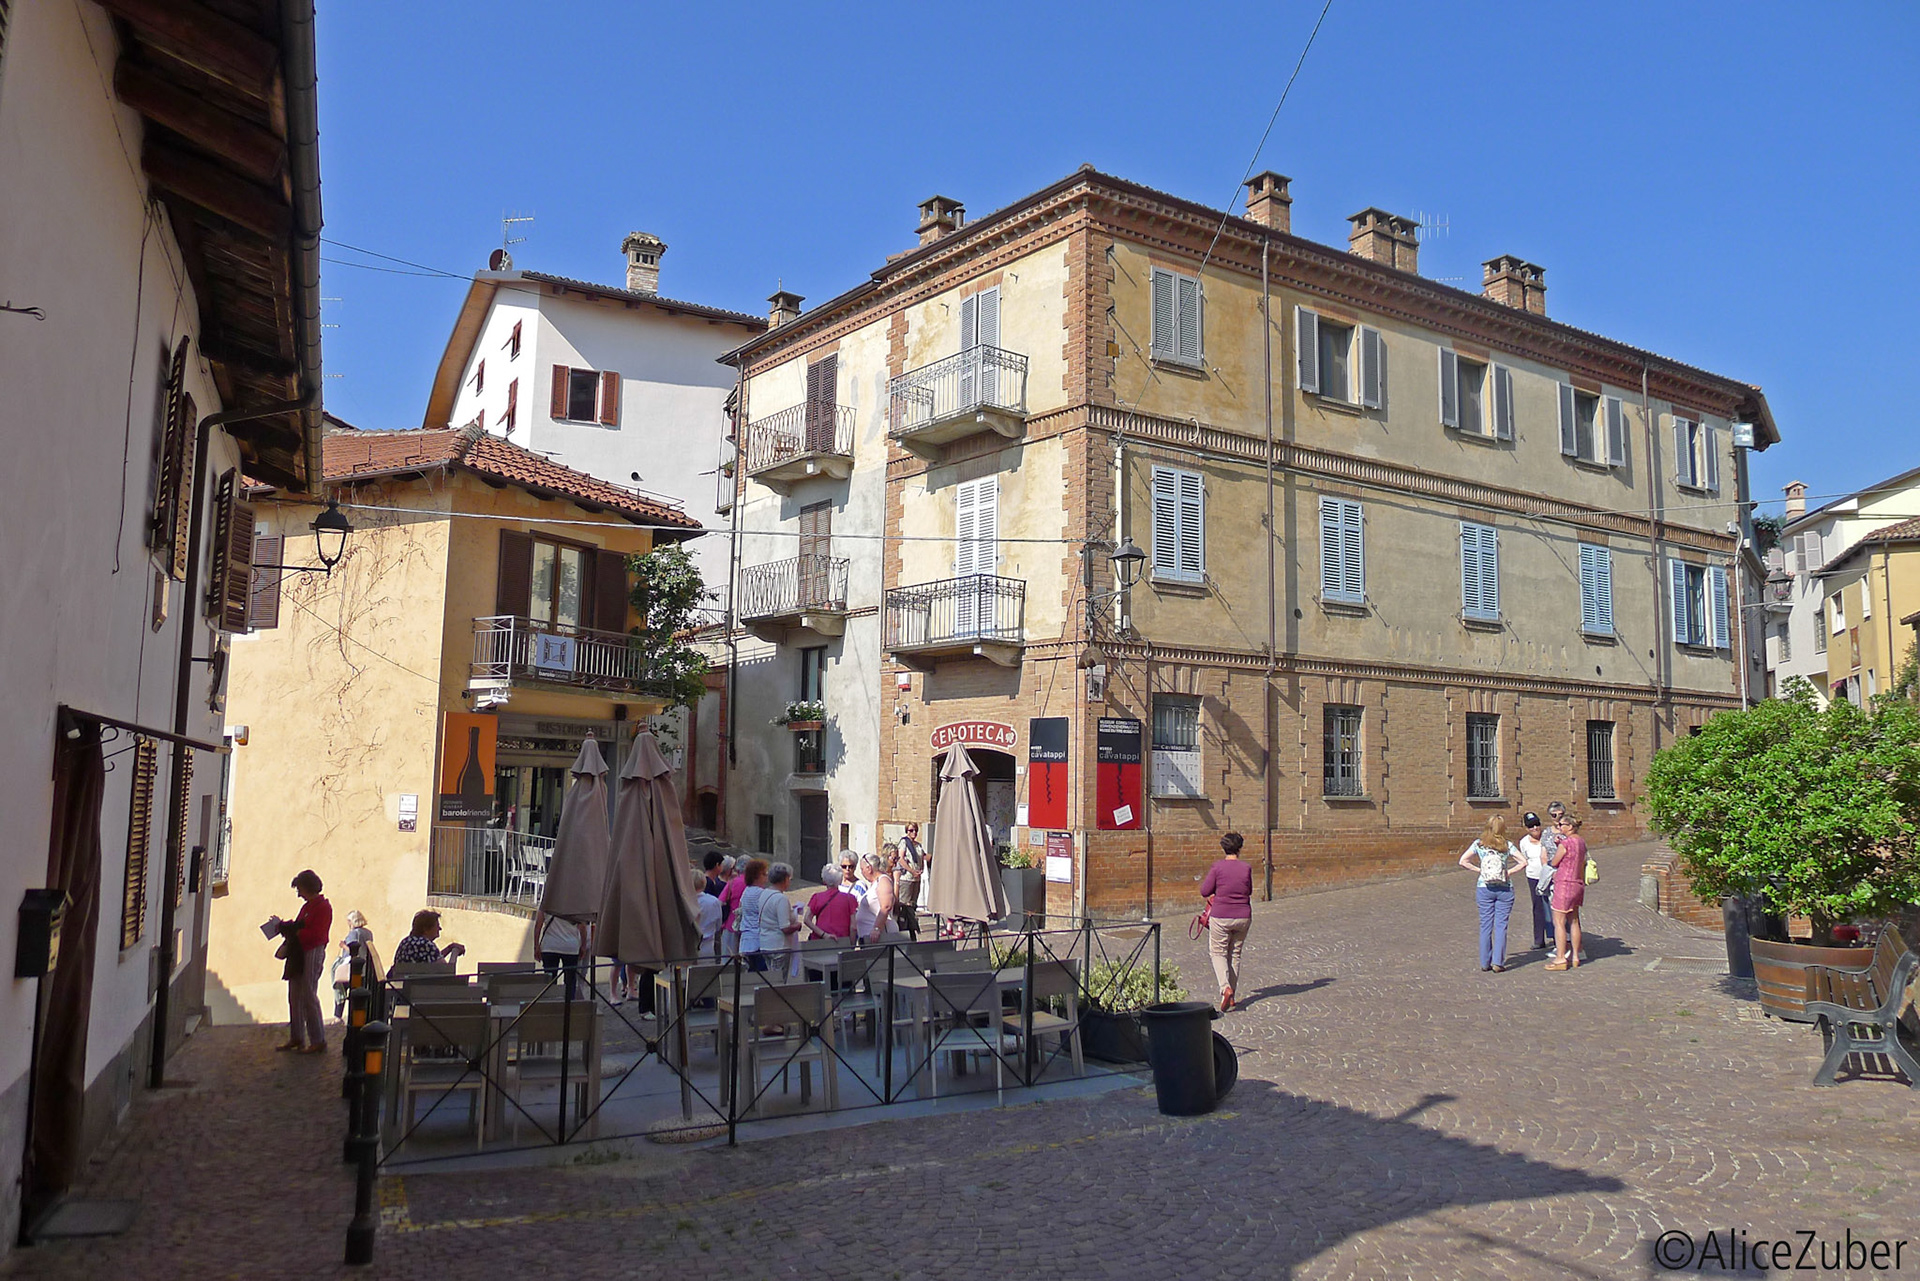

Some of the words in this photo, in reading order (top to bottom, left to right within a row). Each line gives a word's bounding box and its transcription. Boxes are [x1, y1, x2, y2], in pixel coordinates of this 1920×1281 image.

[939, 725, 1004, 744] ENOTECA
[1031, 751, 1066, 759] cavatappi
[1099, 753, 1140, 761] cavatappi
[442, 809, 491, 817] barolofriends
